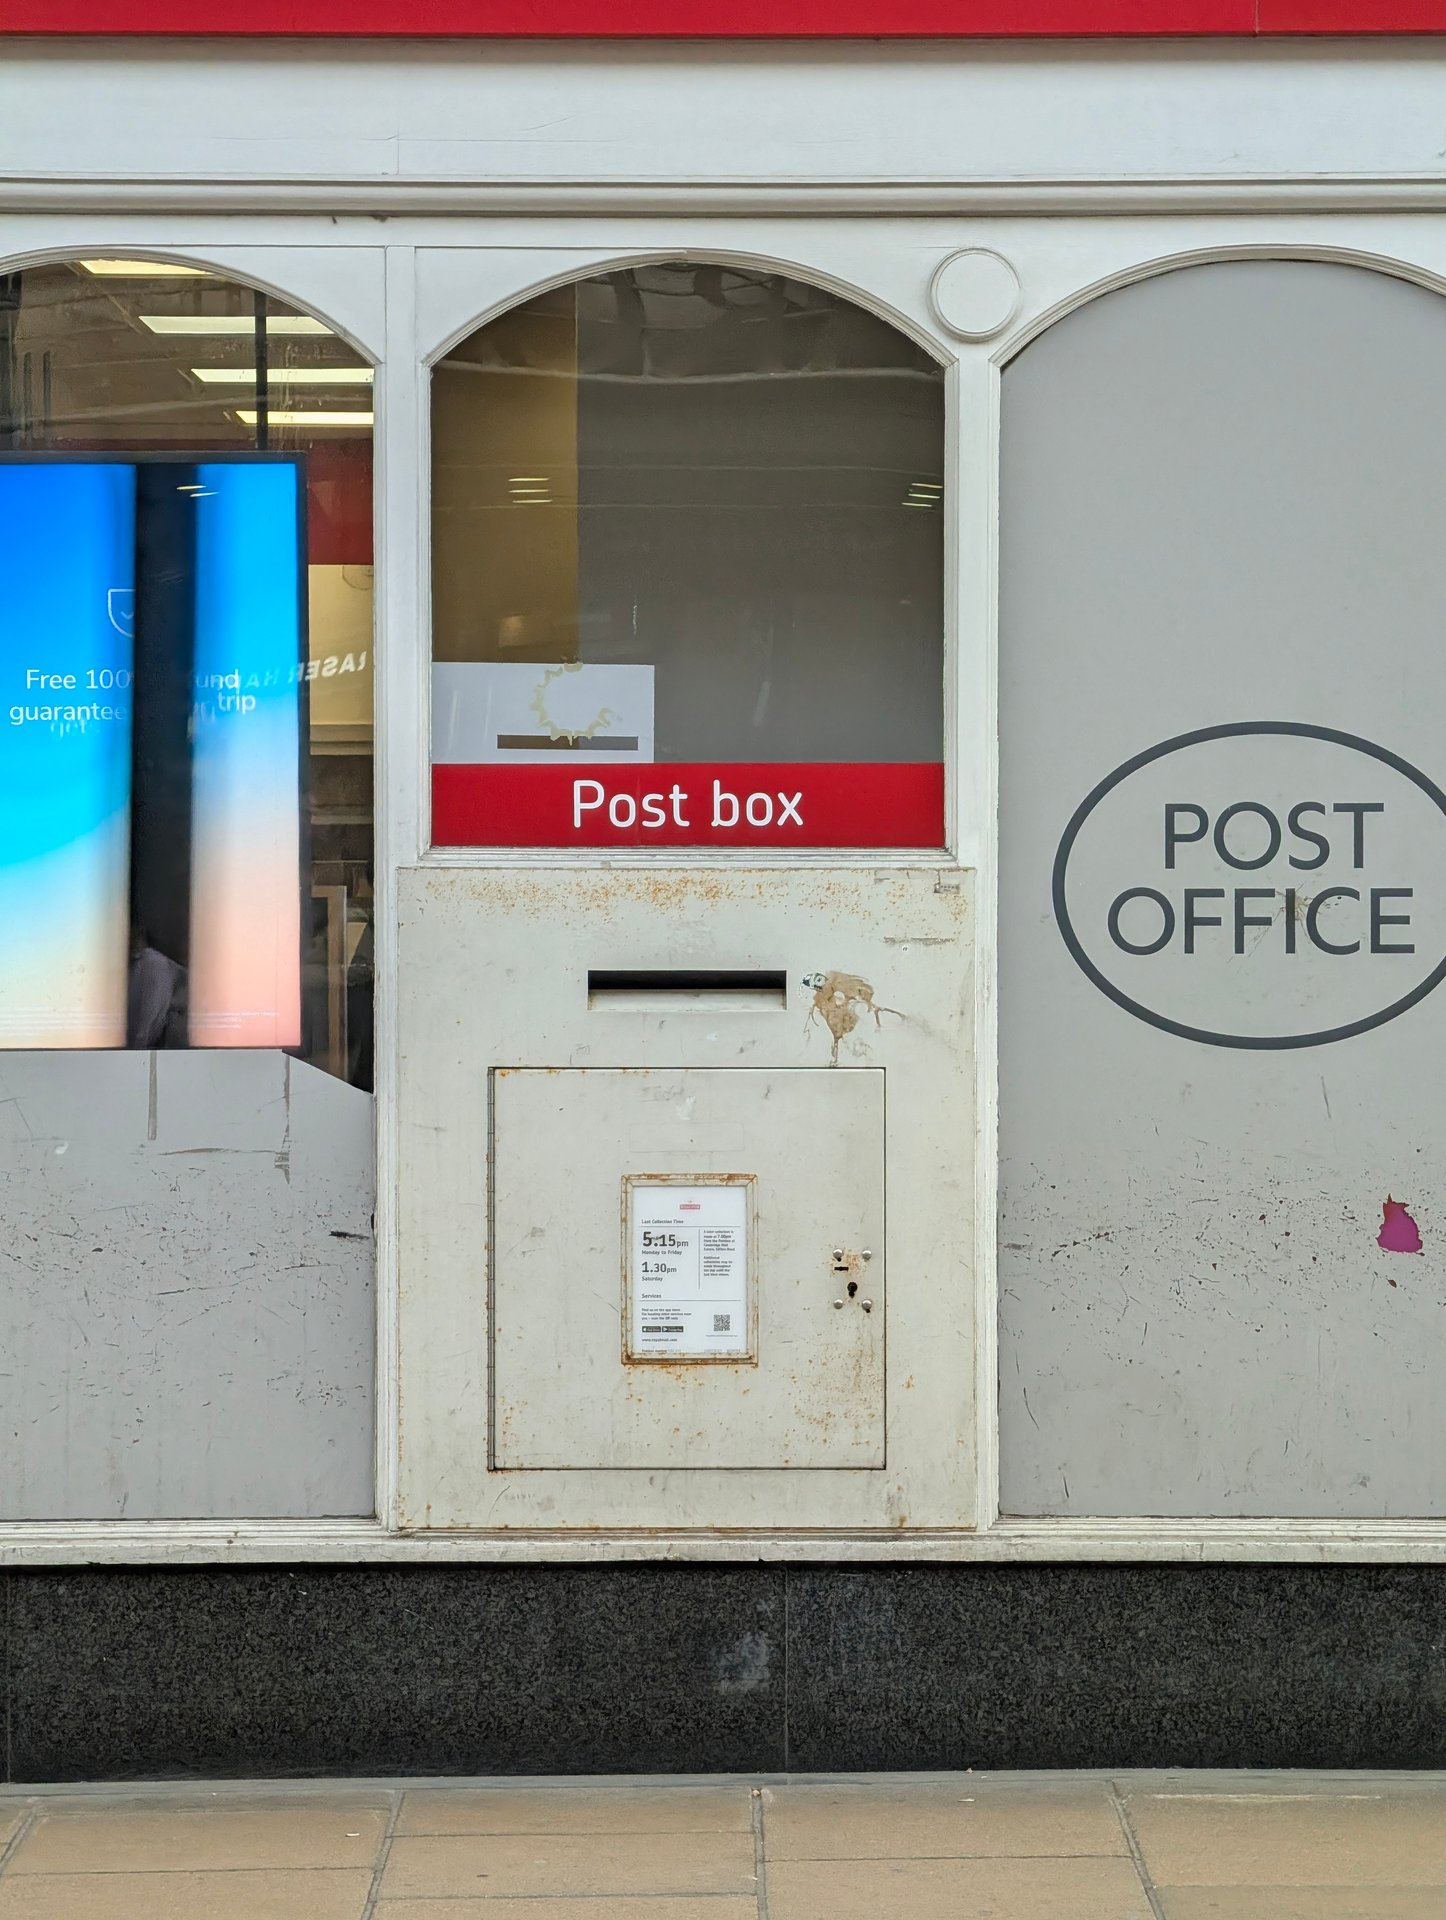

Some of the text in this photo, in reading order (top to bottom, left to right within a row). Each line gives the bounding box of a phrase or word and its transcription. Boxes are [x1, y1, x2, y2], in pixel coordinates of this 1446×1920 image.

[26, 669, 77, 689] Free
[86, 669, 134, 689] 100
[218, 690, 257, 715] trip
[573, 779, 804, 828] Post box
[1164, 801, 1385, 871] POST
[1107, 886, 1415, 956] OFFICE
[643, 1231, 689, 1248] 5.15pm
[642, 1261, 677, 1274] 1.30pm
